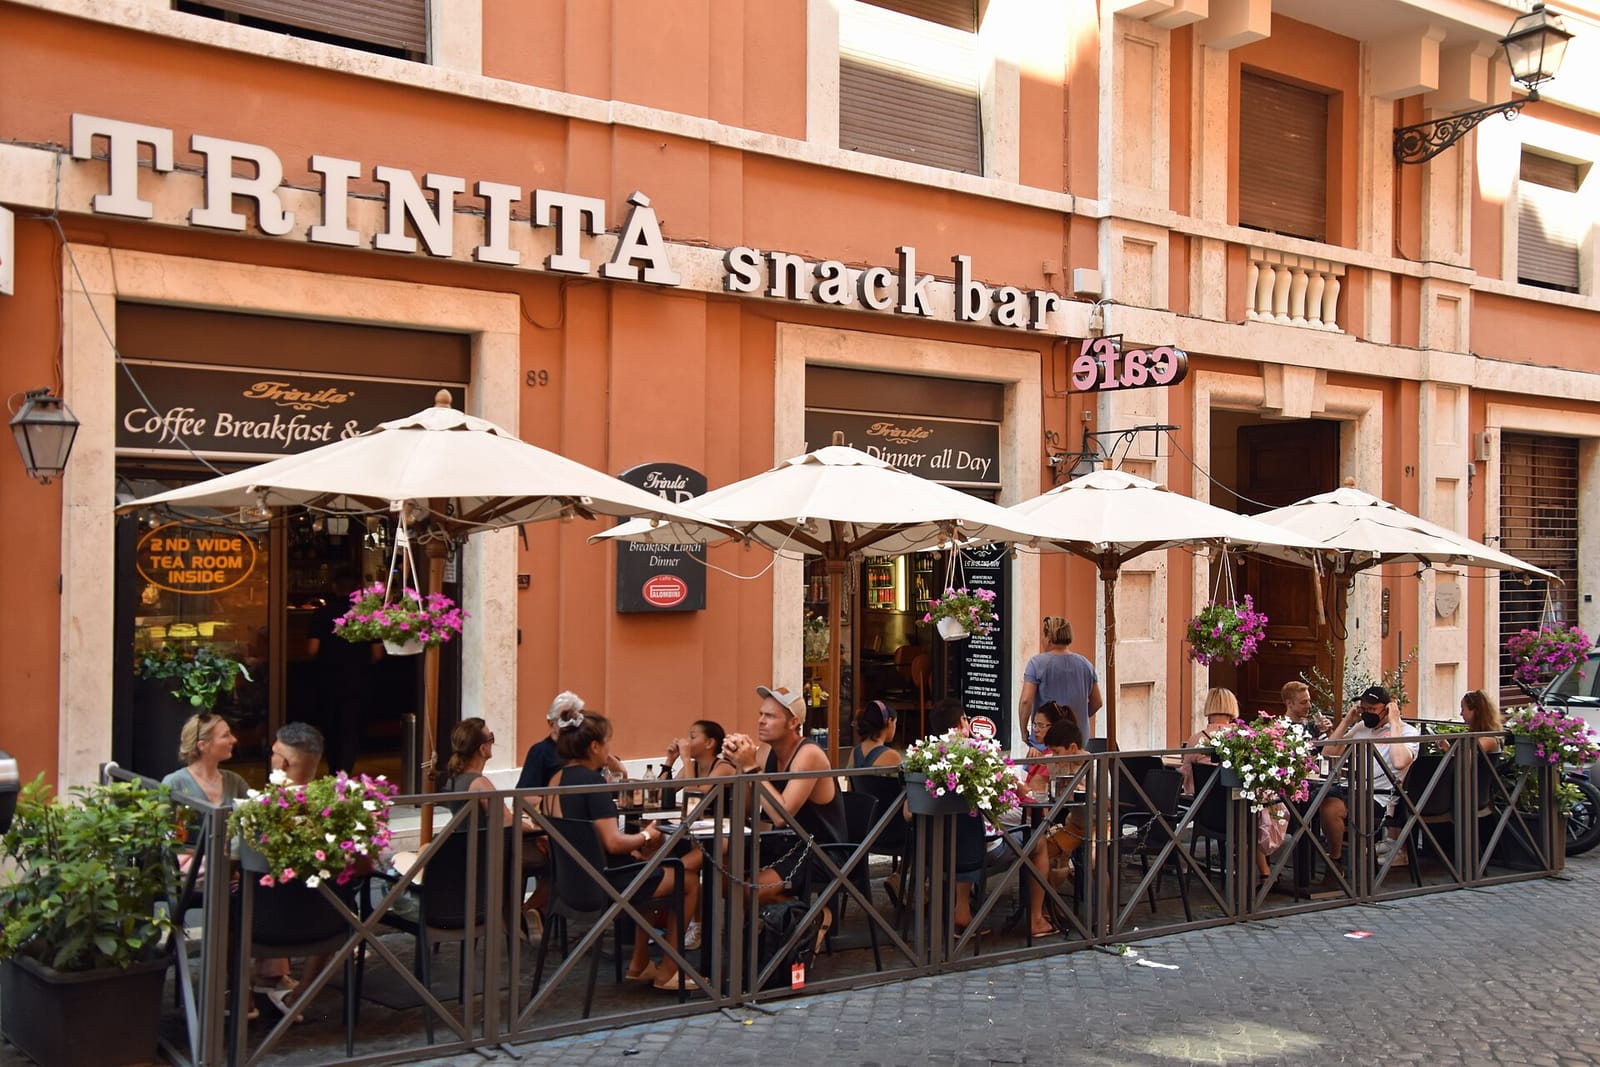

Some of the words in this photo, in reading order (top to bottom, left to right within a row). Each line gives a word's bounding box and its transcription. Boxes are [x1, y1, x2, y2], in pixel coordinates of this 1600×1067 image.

[71, 112, 681, 286] TRINITÀ
[723, 245, 935, 318] snack
[953, 254, 1062, 331] bar
[526, 369, 549, 387] 89
[123, 407, 206, 443] Coffee
[214, 412, 333, 448] Breakfast
[340, 420, 361, 441] &
[930, 449, 952, 469] all
[956, 451, 992, 479] Day
[196, 538, 242, 552] WIDE
[150, 555, 185, 569] TEA
[191, 555, 243, 569] ROOM
[649, 555, 681, 567] Dinner
[168, 570, 225, 584] INSIDE
